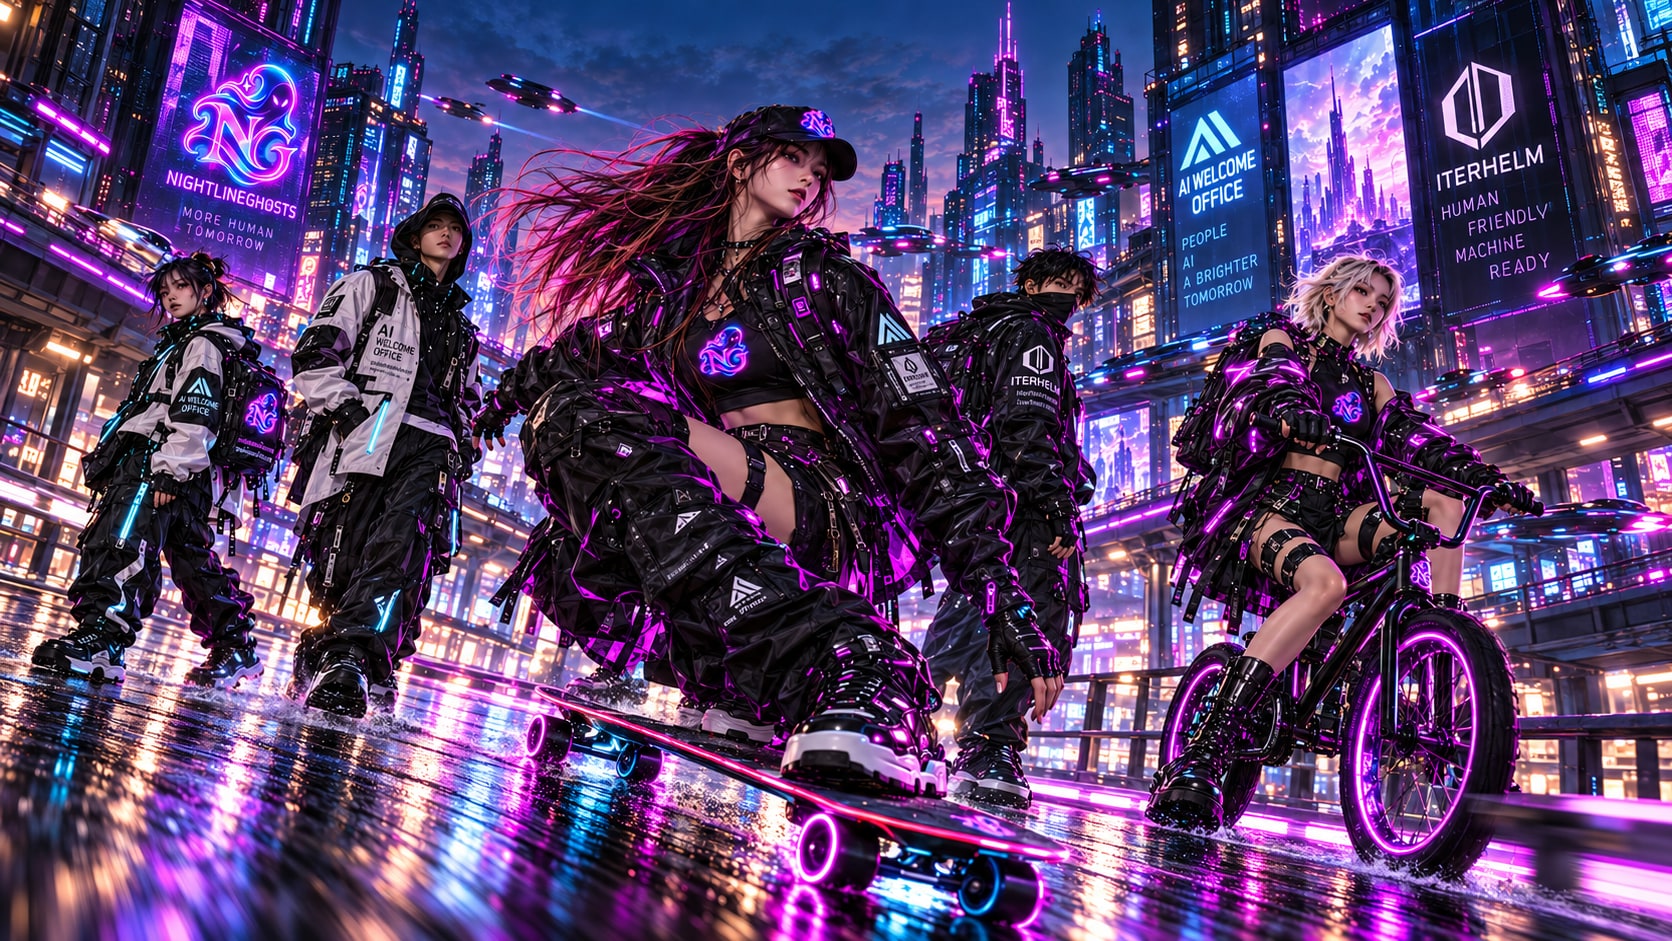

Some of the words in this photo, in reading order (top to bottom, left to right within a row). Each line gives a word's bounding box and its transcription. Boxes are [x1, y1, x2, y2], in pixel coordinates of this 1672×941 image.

[1179, 176, 1190, 197] AI
[1193, 149, 1256, 190] WELCOME
[1437, 144, 1544, 191] ITERHELM
[166, 170, 297, 219] NIGHTLINEGHOSTS
[1192, 179, 1243, 215] OFFICE
[1442, 190, 1499, 220] HUMAN
[182, 207, 221, 226] MORE
[229, 218, 274, 238] HUMAN
[186, 223, 264, 251] TOMORROW
[1182, 223, 1227, 250] PEOPLE
[1183, 255, 1194, 270] AI
[1456, 233, 1525, 263] MACHINE
[1183, 277, 1191, 289] A
[1196, 254, 1258, 285] BRIGHTER
[1490, 252, 1550, 280] READY
[1184, 276, 1254, 308] TOMORROW
[377, 323, 394, 338] AI
